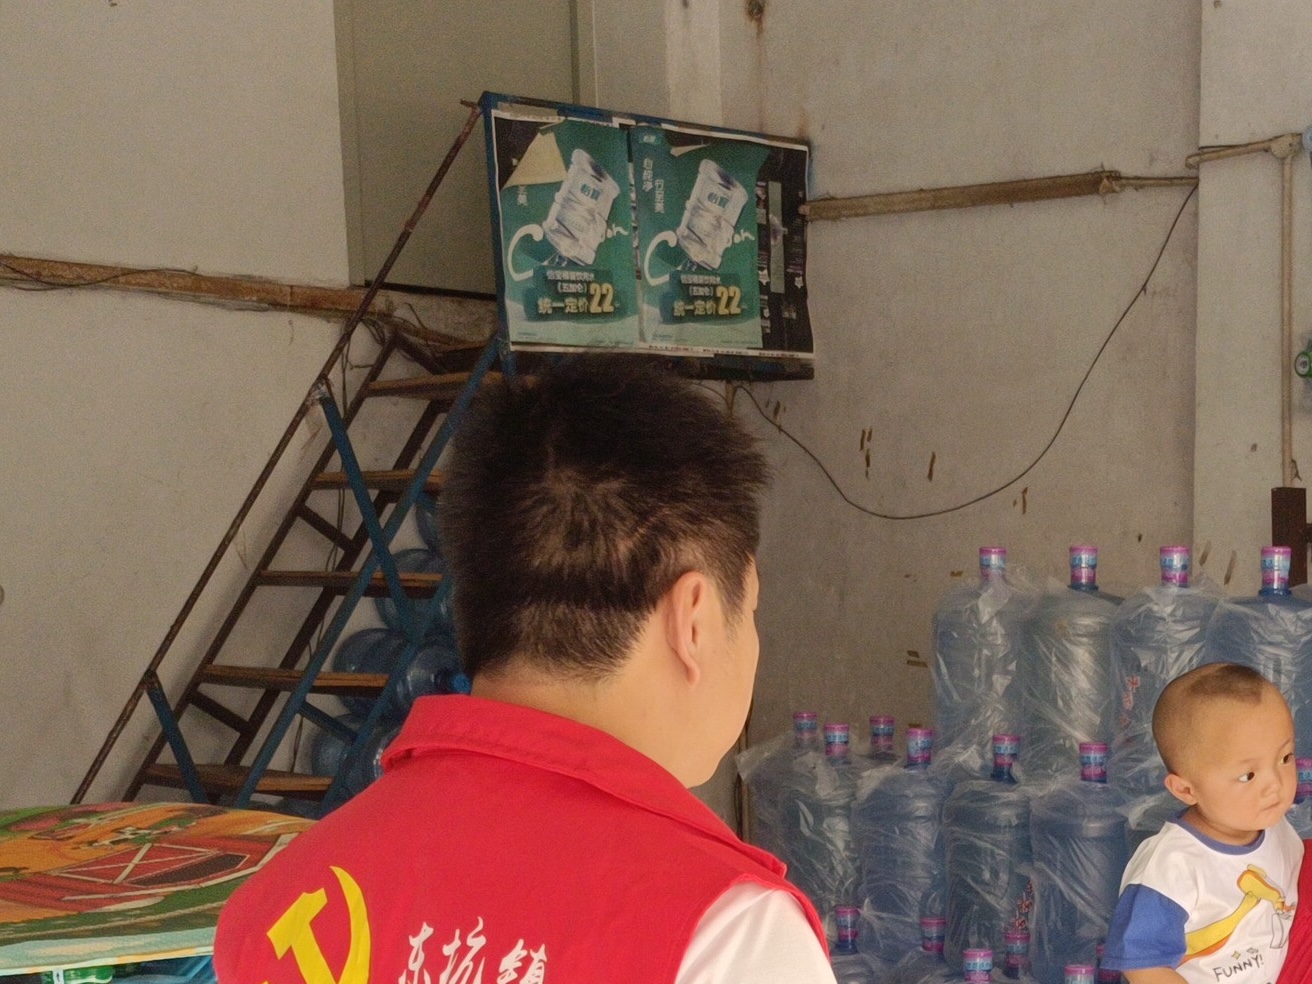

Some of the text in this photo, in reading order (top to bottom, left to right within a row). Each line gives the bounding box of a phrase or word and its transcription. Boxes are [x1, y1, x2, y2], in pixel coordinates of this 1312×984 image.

[537, 282, 615, 315] 统一定价 22
[716, 285, 742, 316] 22
[1212, 954, 1265, 983] FUNNY!
